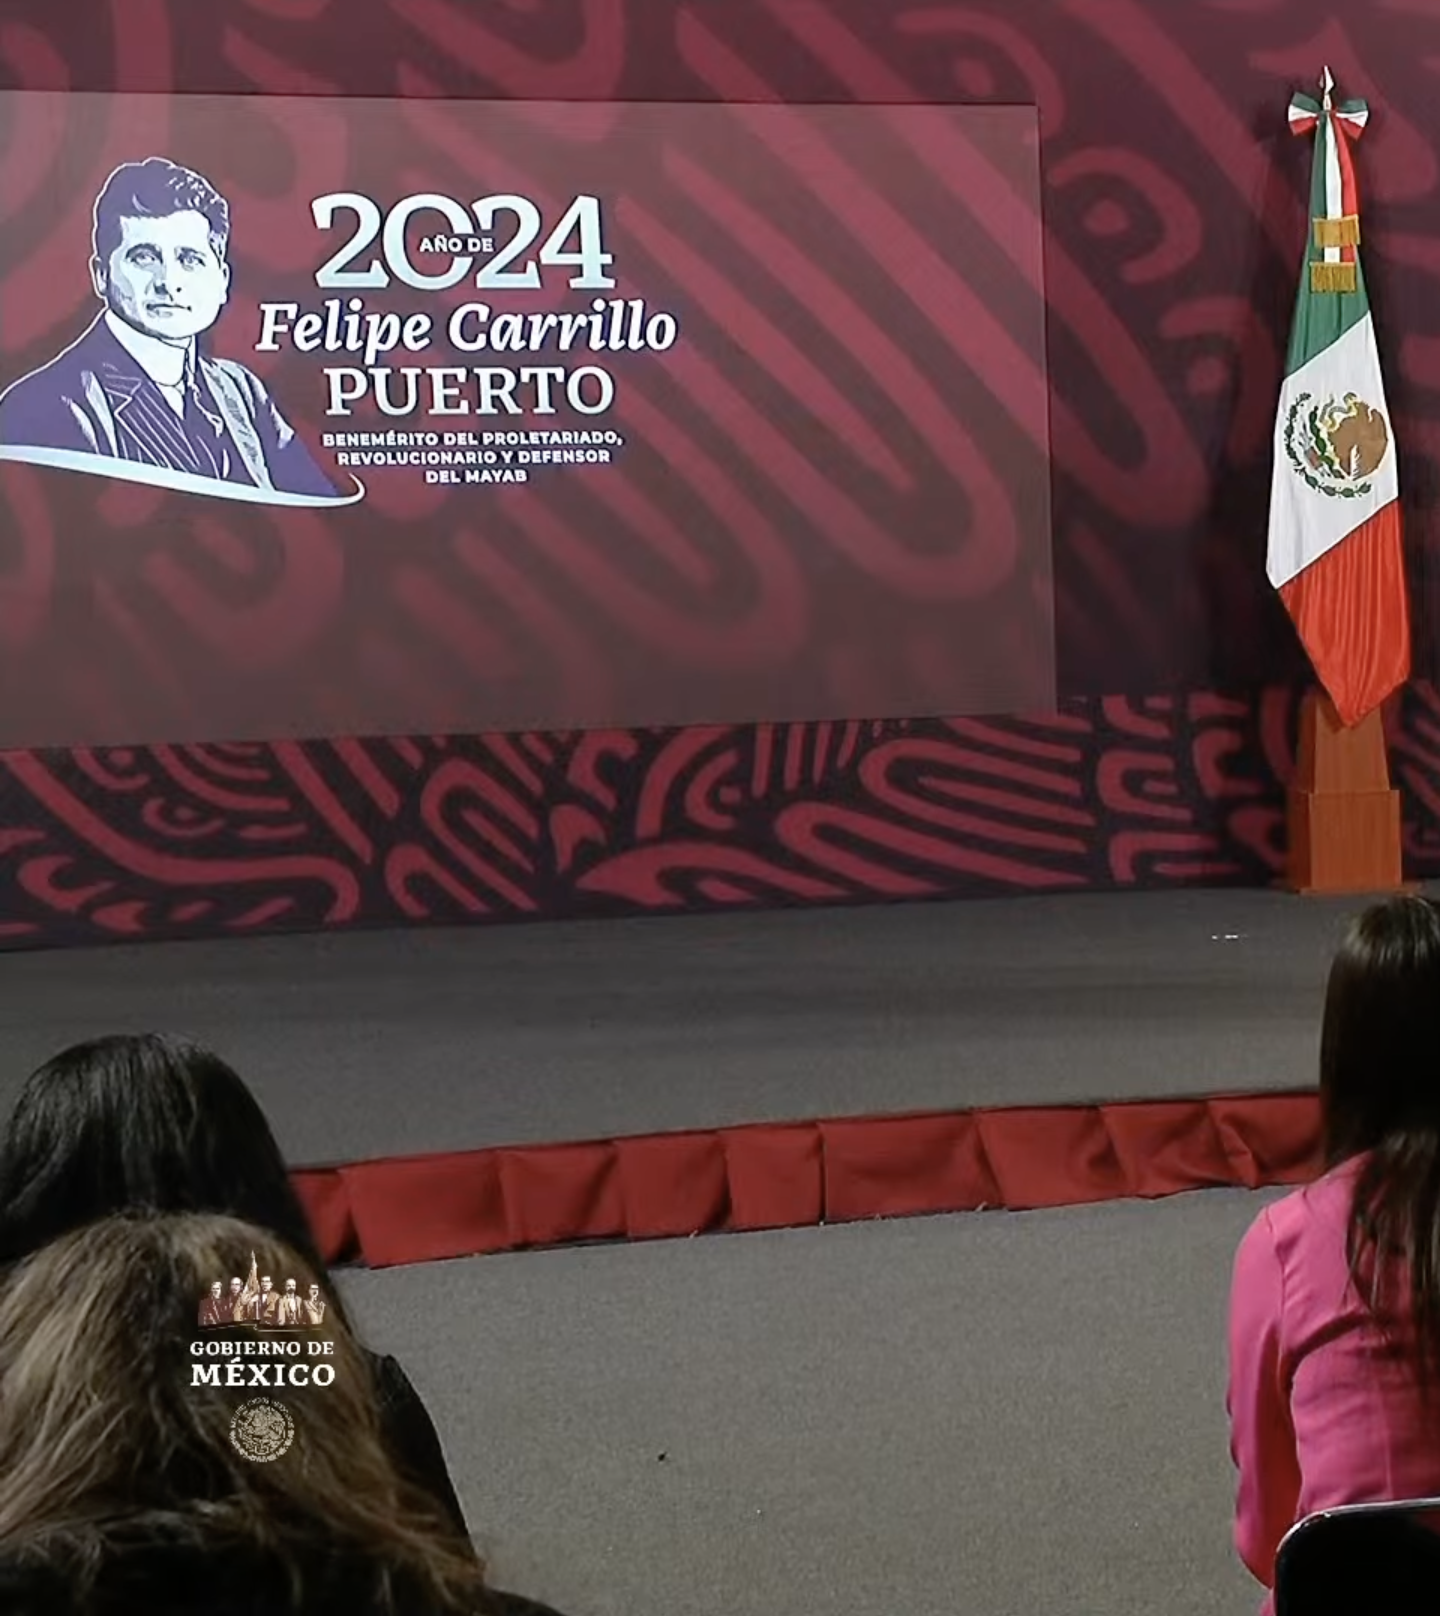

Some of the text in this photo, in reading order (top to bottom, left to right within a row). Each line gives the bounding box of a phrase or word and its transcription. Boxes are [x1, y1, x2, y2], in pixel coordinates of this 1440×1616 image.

[311, 194, 615, 289] 2024
[419, 233, 494, 254] AÑO DE
[255, 297, 677, 364] Felipe Carrillo
[323, 366, 614, 417] PUERTO
[322, 429, 624, 448] BENEMÉRITO DEL PROLETARIADO,
[337, 448, 611, 466] REVOLUCIONARIO Y DEFENSOR
[425, 468, 528, 485] DEL MAYAB
